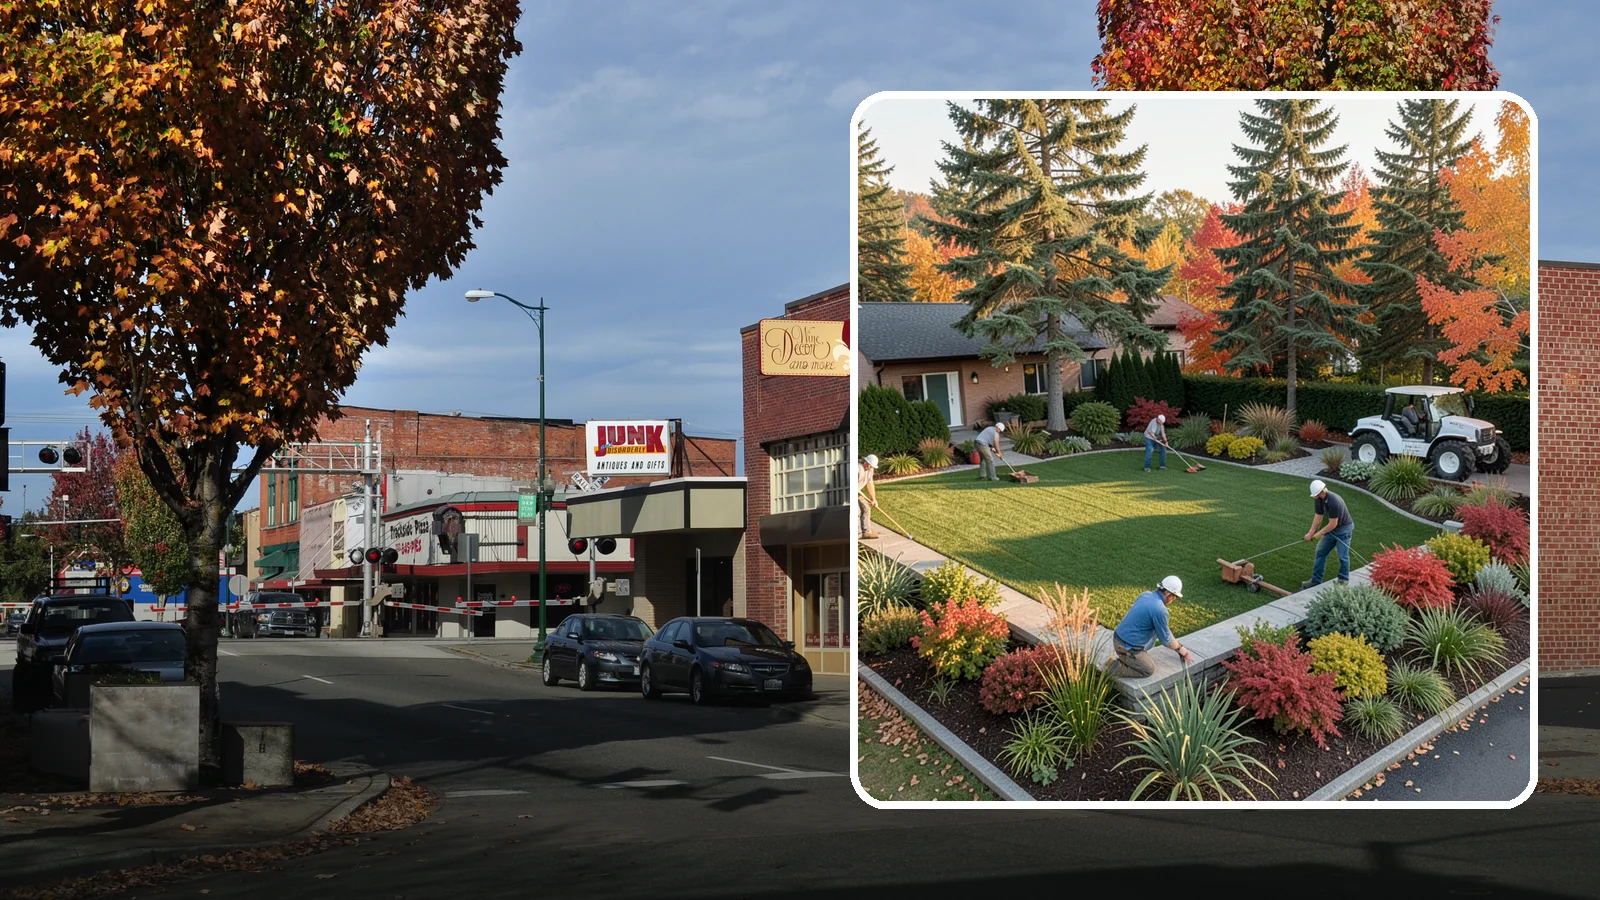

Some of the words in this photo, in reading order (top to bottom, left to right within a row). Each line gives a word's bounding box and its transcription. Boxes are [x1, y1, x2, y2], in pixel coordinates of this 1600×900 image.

[595, 425, 665, 457] JUNK
[607, 446, 646, 454] DISORDERLY
[597, 461, 628, 470] ANTIQUES
[631, 461, 644, 470] AND
[647, 461, 665, 470] GIFTS
[415, 519, 429, 534] Pizza
